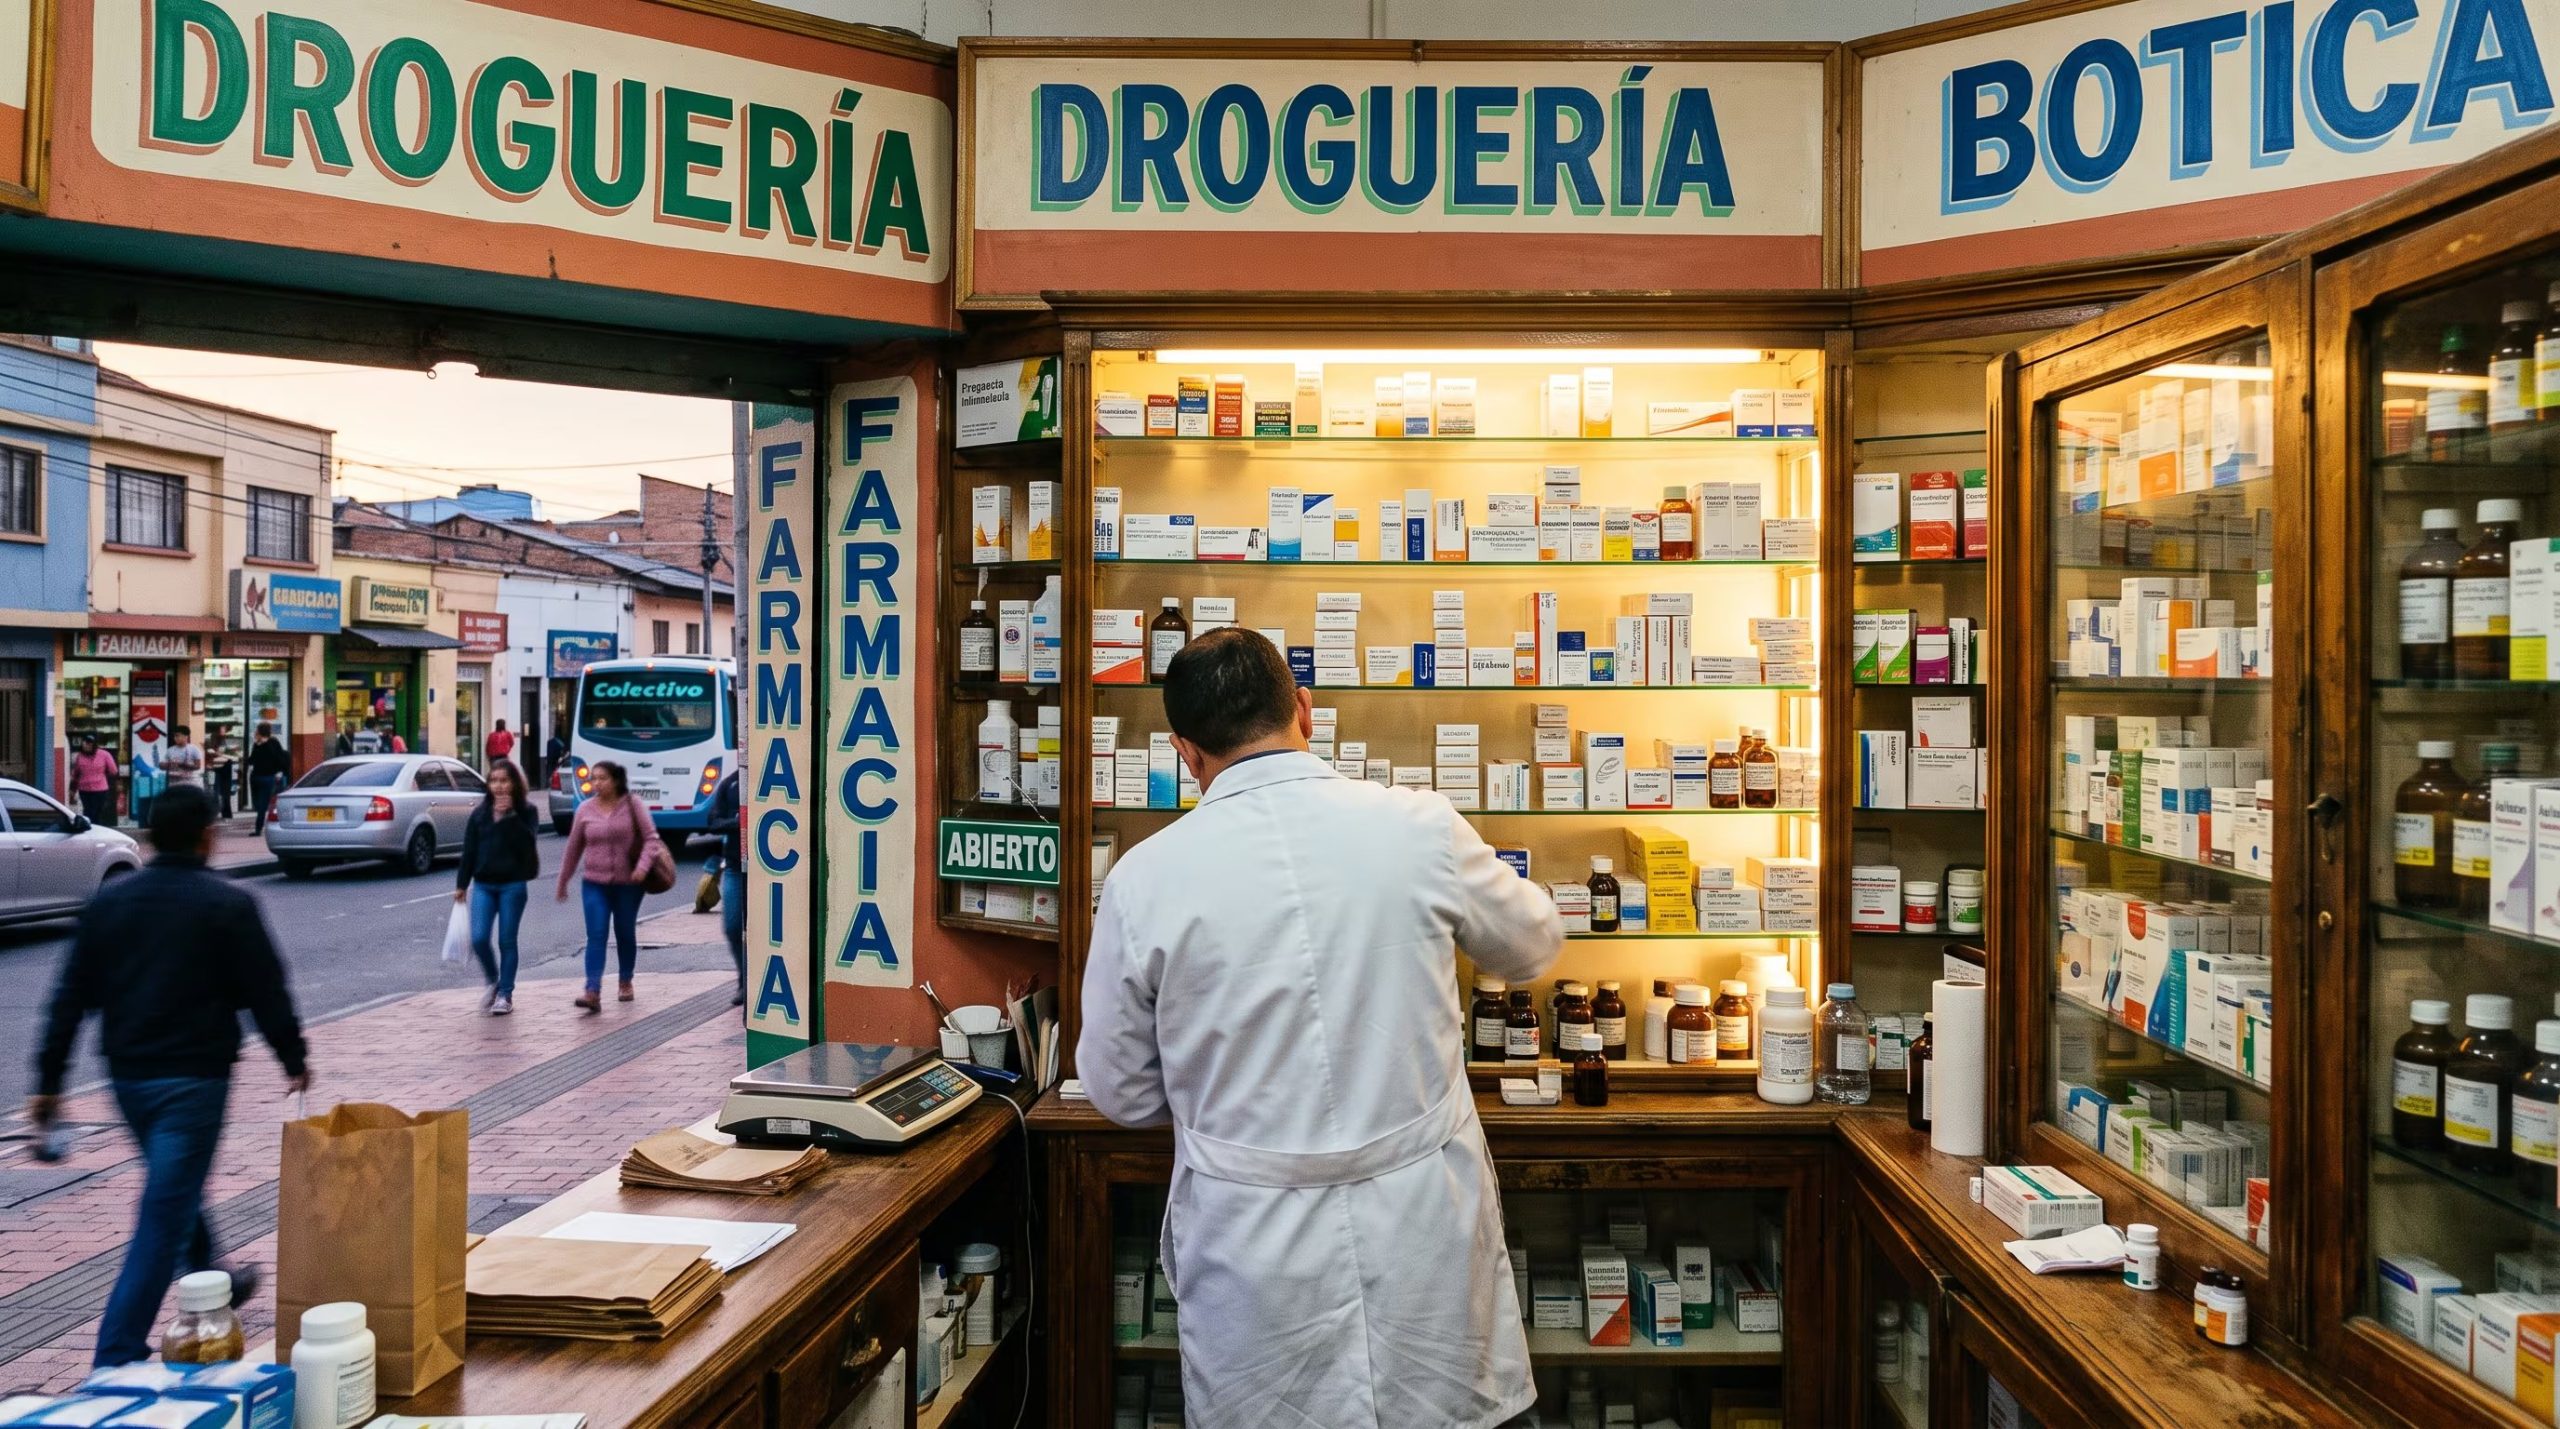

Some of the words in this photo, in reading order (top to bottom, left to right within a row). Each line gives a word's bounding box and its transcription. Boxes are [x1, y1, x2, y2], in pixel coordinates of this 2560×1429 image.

[139, 0, 932, 263] DROGUERÍA
[1031, 65, 1736, 217] DROGUERÍA
[1941, 0, 2559, 215] BOTICA
[97, 634, 188, 657] FARMACIA
[593, 681, 704, 698] Colectivo
[753, 441, 803, 1026] FARMACIA
[835, 396, 902, 970] FARMACIA
[946, 831, 1057, 874] ABIERTO
